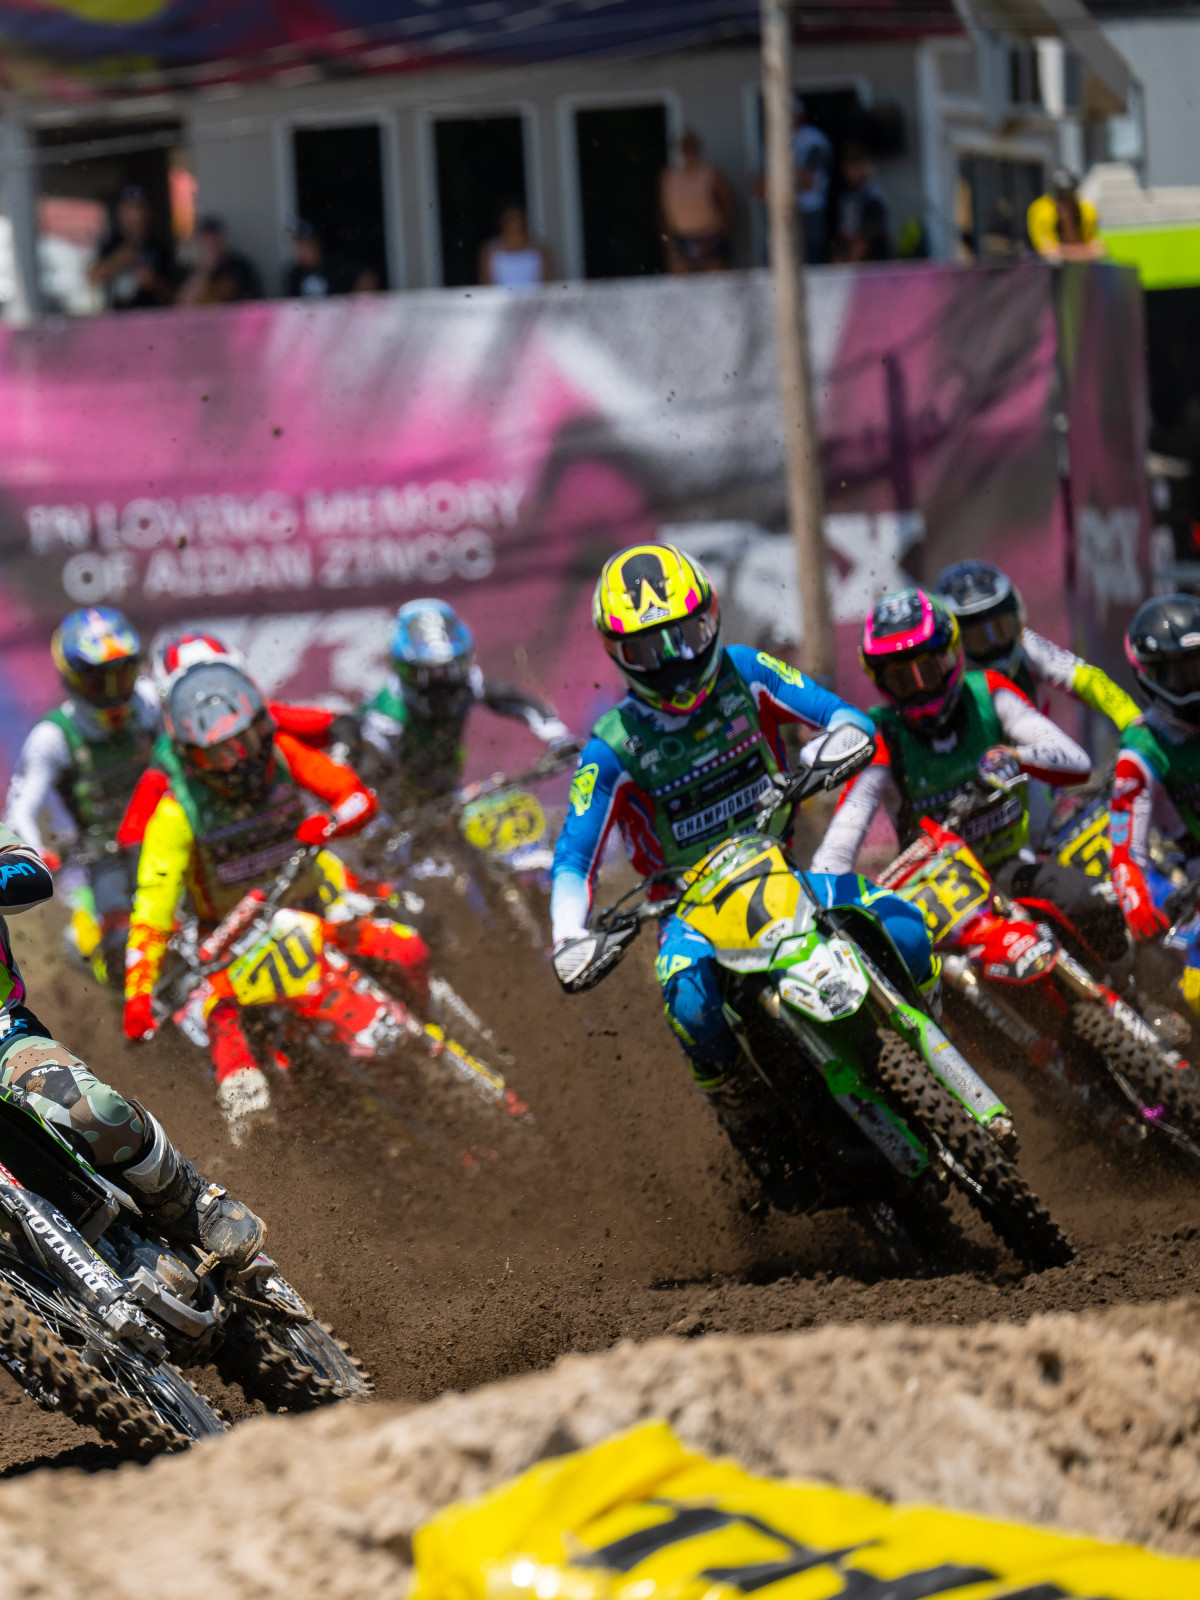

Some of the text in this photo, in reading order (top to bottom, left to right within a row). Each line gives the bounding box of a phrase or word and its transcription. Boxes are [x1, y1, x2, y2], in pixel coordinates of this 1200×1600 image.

[676, 776, 771, 838] CHAMPIONSHIP
[712, 856, 774, 942] 7
[248, 926, 318, 998] 70
[25, 1204, 112, 1293] DUNLO
